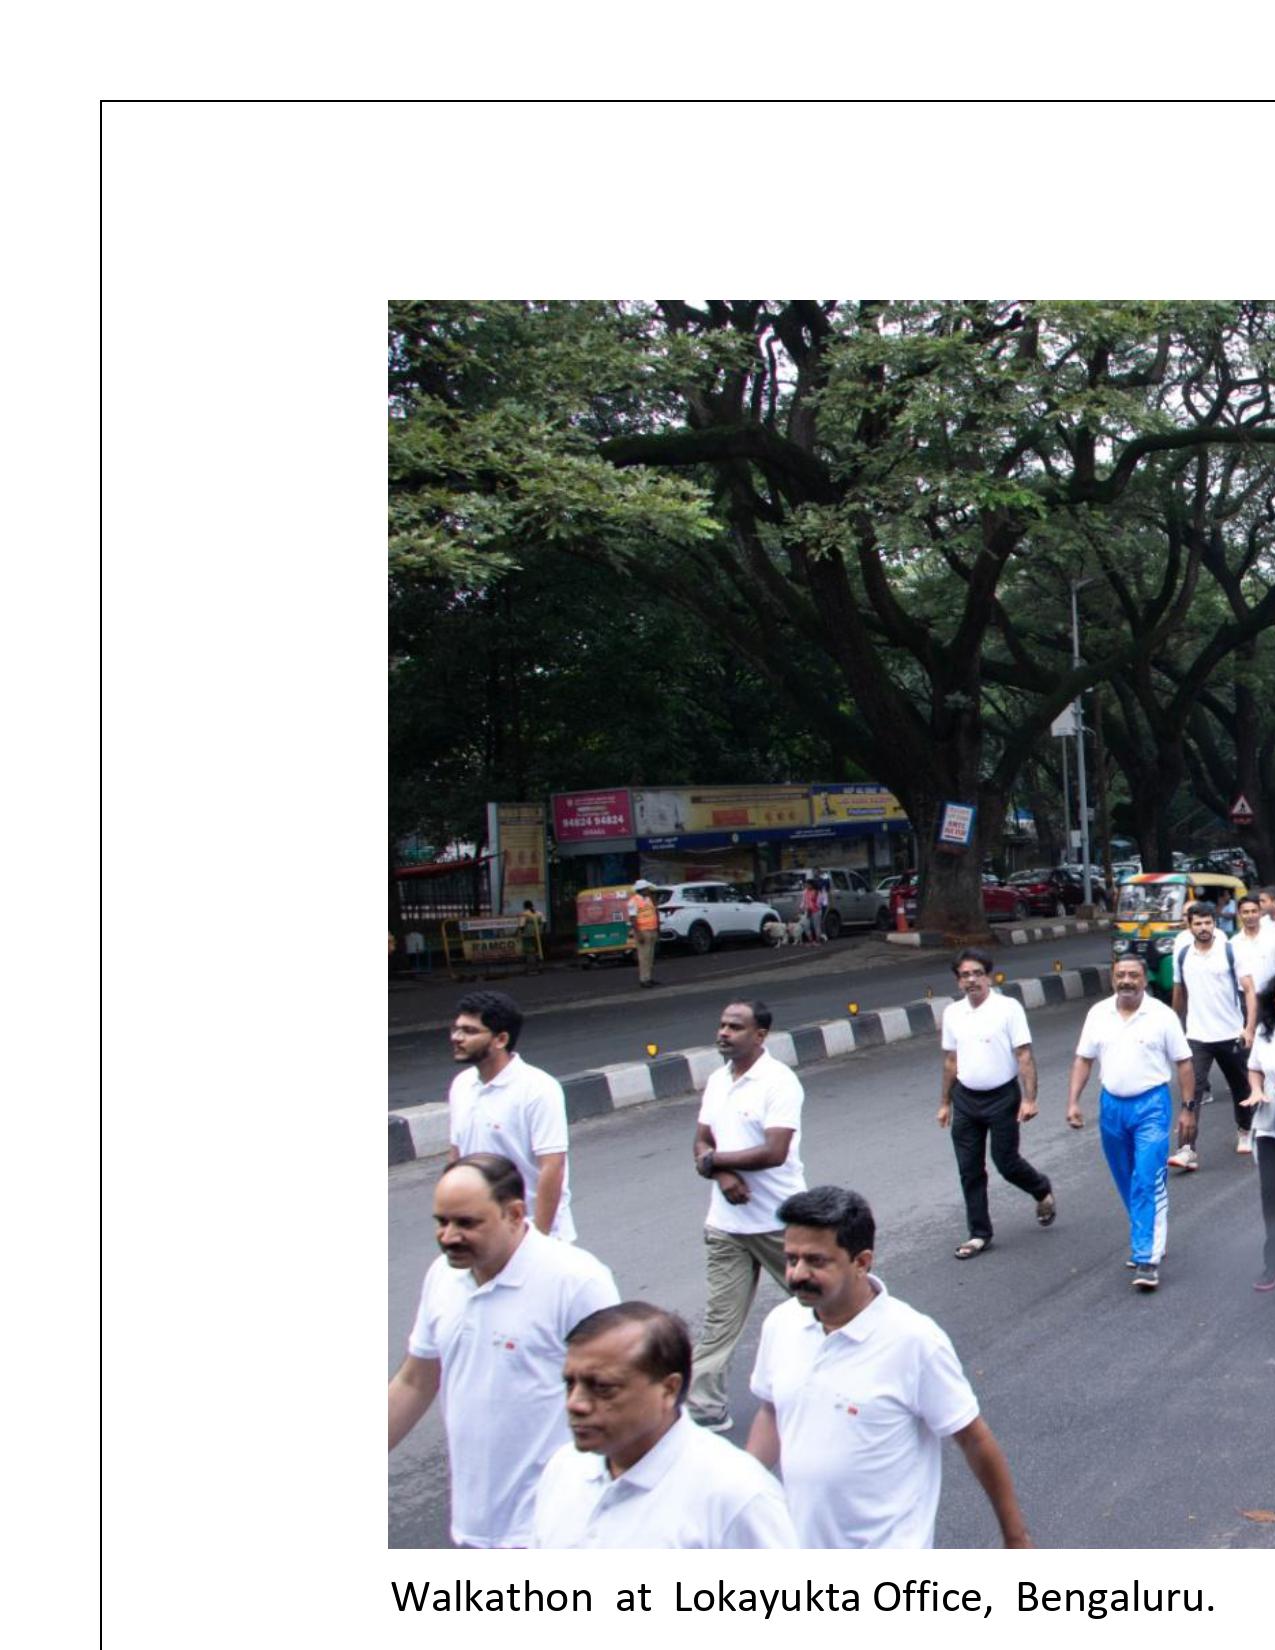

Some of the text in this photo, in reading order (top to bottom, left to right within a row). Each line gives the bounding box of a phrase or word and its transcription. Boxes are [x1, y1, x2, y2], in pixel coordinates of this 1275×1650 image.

[391, 1580, 1213, 1619] Walkathon at Lokayukta Office, Bengaluru.
